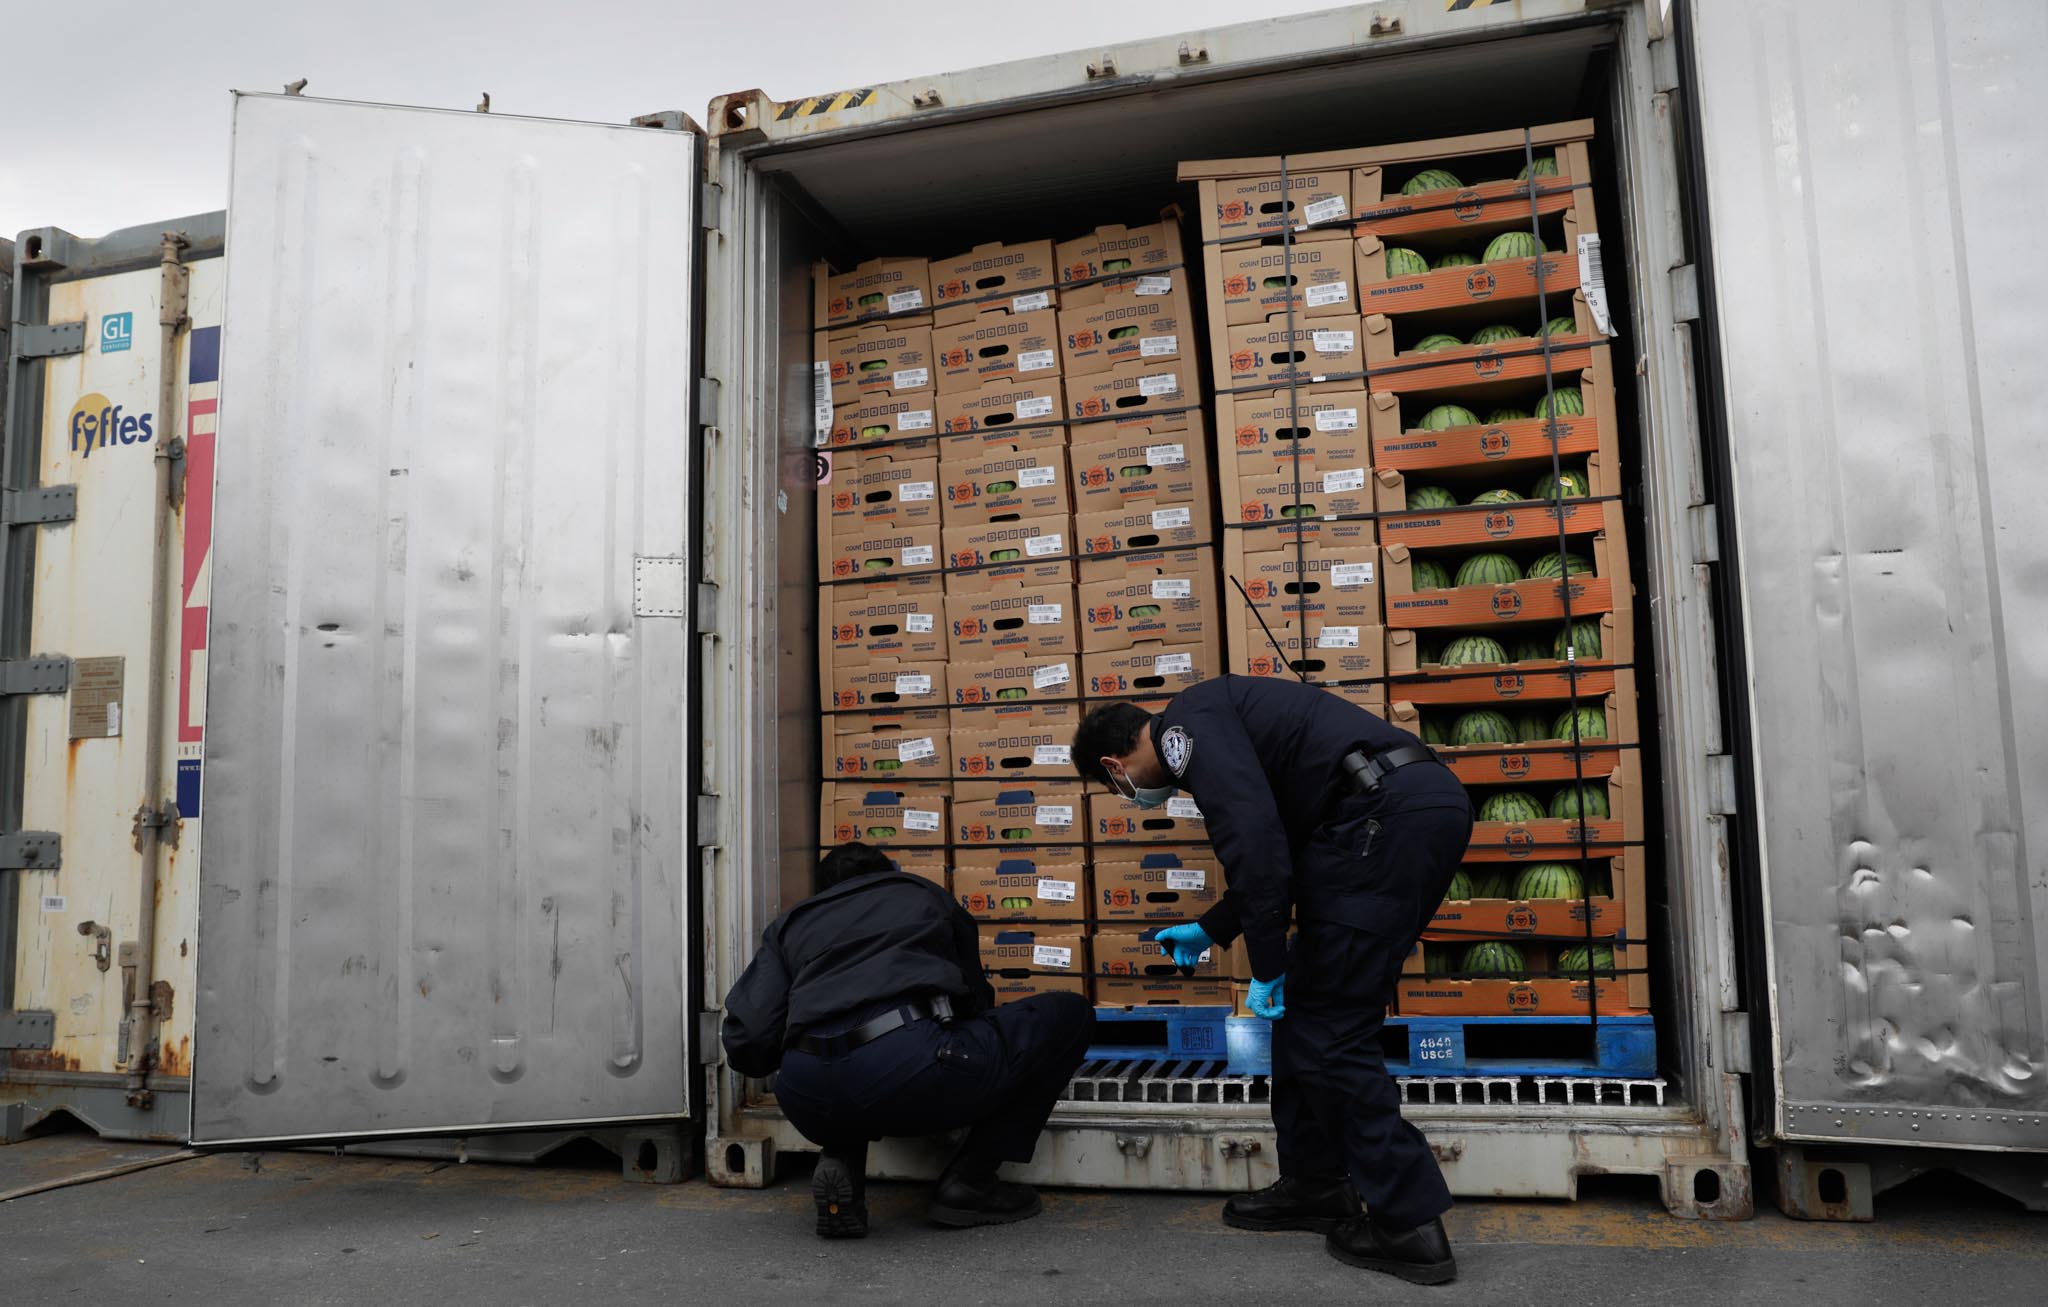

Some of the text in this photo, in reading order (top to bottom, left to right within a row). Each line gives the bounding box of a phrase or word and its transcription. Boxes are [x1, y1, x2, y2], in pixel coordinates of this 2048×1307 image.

[1237, 186, 1257, 194] COUNT
[1257, 219, 1299, 229] WATERMON
[1239, 260, 1259, 269] COUNT
[1388, 283, 1424, 294] SEEDLESS
[1260, 295, 1302, 305] WATERMON
[103, 316, 130, 340] GL
[1246, 336, 1267, 344] COUNT
[1267, 371, 1311, 381] WATERELON
[1093, 383, 1112, 392] COUNT
[962, 401, 980, 409] COUNT
[1251, 411, 1272, 419] COUNT
[72, 405, 152, 458] fyffes
[1401, 441, 1437, 450] SEEDLESS
[1098, 452, 1116, 460] COUNT
[1272, 448, 1316, 458] WATERELON
[965, 468, 983, 476] COUNT
[1256, 487, 1277, 495] COUNT
[1104, 520, 1123, 528] COUNT
[1404, 519, 1441, 528] SEEDLESS
[1277, 524, 1320, 534] WATERELON
[968, 536, 986, 544] COUNT
[1260, 564, 1281, 572] COUNT
[1281, 603, 1325, 612] WATEMELON
[1394, 598, 1449, 609] MINI SEEDLESS
[1111, 659, 1130, 667] COUNT
[1123, 873, 1142, 881] COUNT
[1431, 913, 1462, 921] EDLESS
[1421, 1049, 1453, 1060] USCE
